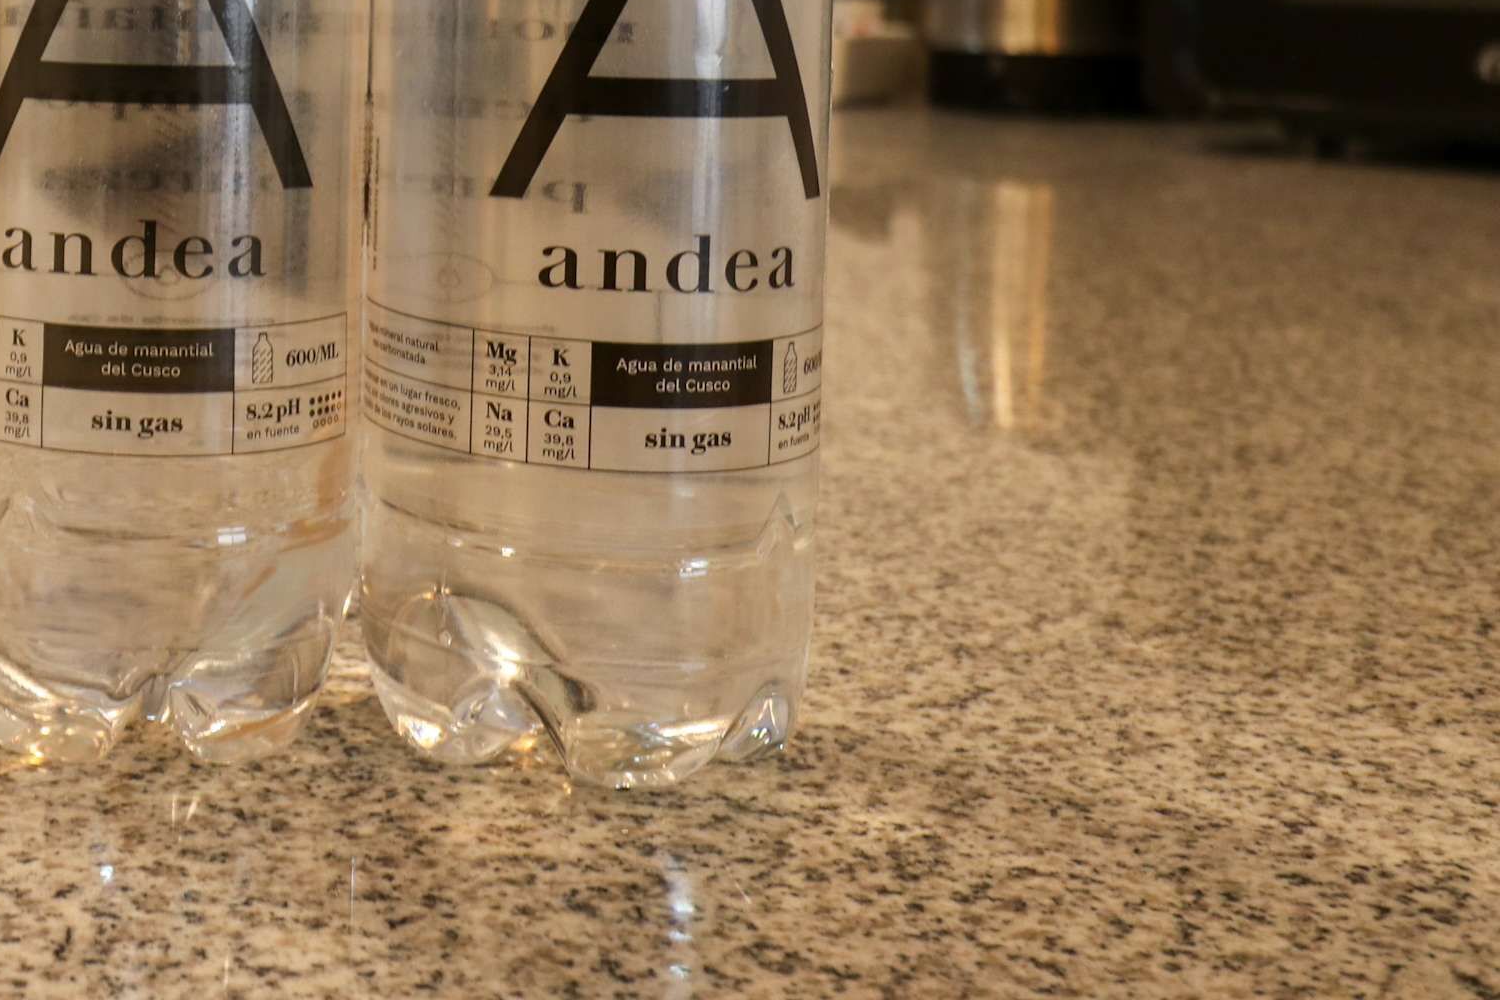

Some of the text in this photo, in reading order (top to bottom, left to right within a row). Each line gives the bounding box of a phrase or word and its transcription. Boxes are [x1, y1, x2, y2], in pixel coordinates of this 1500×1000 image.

[2, 220, 267, 279] andea
[538, 234, 795, 293] andea
[12, 329, 25, 346] K
[405, 336, 438, 352] natural
[65, 339, 214, 357] Agua de manantial
[285, 342, 339, 368] 600/ML
[486, 341, 517, 366] Mg
[552, 348, 570, 367] K
[616, 355, 757, 375] Agua de manantial
[5, 365, 31, 378] mg/l
[101, 361, 181, 378] del Cusco
[489, 364, 512, 377] 3,14
[550, 371, 571, 384] 0,9
[486, 379, 515, 392] mg/l
[544, 385, 577, 399] mg/l
[655, 378, 730, 393] del Cusco
[5, 388, 29, 408] Ca
[425, 391, 461, 411] fresco,
[448, 414, 455, 425] y
[486, 401, 512, 422] Na
[544, 409, 574, 429] Ca
[4, 425, 30, 438] mg/l
[91, 410, 184, 439] sin gas
[247, 424, 300, 440] en fuente
[485, 425, 512, 439] 29,5
[484, 439, 513, 454] mg/l
[543, 433, 574, 446] 39,8
[644, 427, 732, 455] sin gas
[542, 447, 575, 461] mg/l
